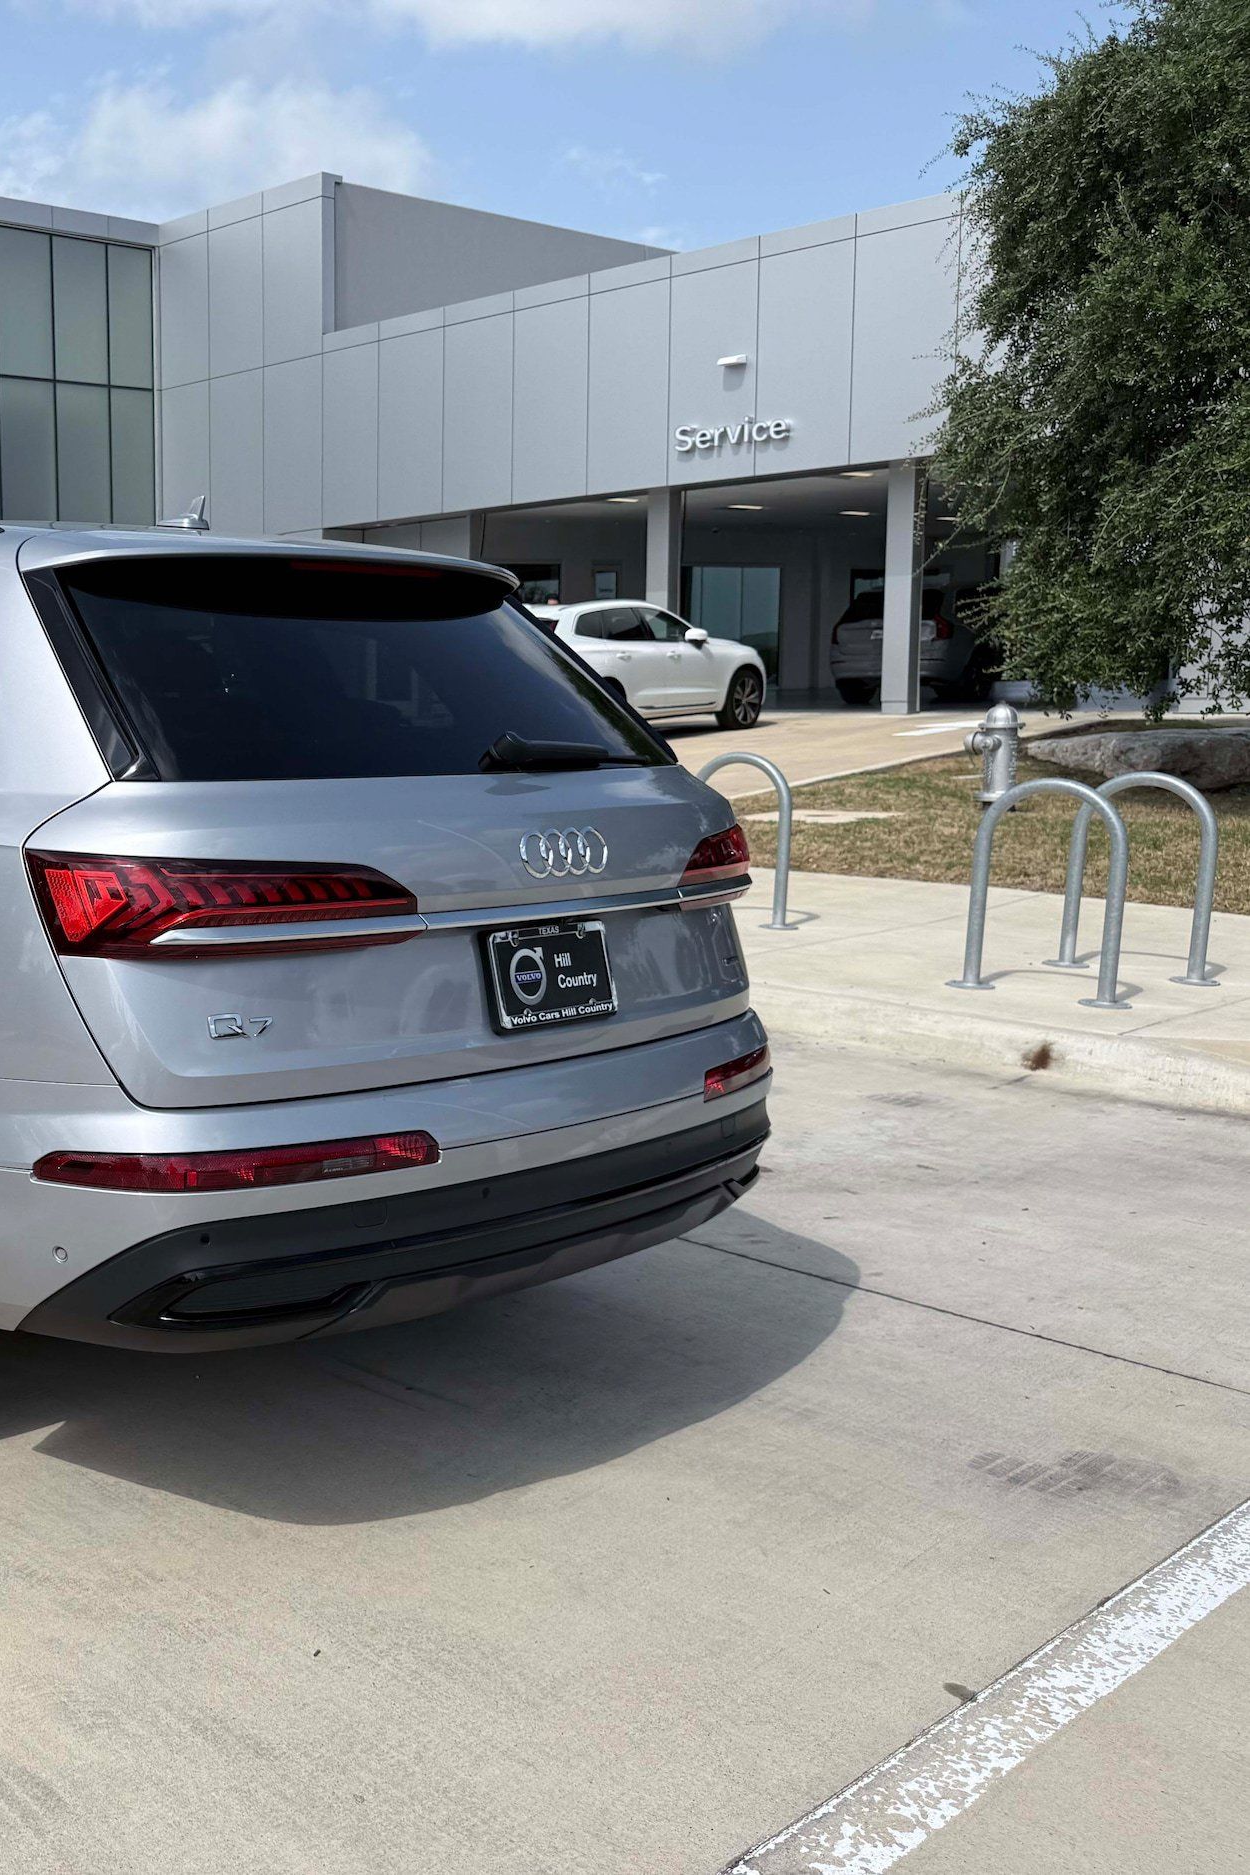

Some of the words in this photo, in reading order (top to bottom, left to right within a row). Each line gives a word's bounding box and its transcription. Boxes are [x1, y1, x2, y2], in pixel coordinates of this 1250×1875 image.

[675, 416, 790, 452] Service
[538, 926, 560, 935] TEXAS
[554, 952, 572, 968] Hill
[516, 972, 541, 981] VOLVO
[557, 972, 597, 988] Country
[511, 1014, 537, 1026] Volvo
[539, 1011, 561, 1021] Cars
[562, 1007, 577, 1017] Hill
[578, 1002, 613, 1014] Country
[207, 1013, 273, 1040] Q7
